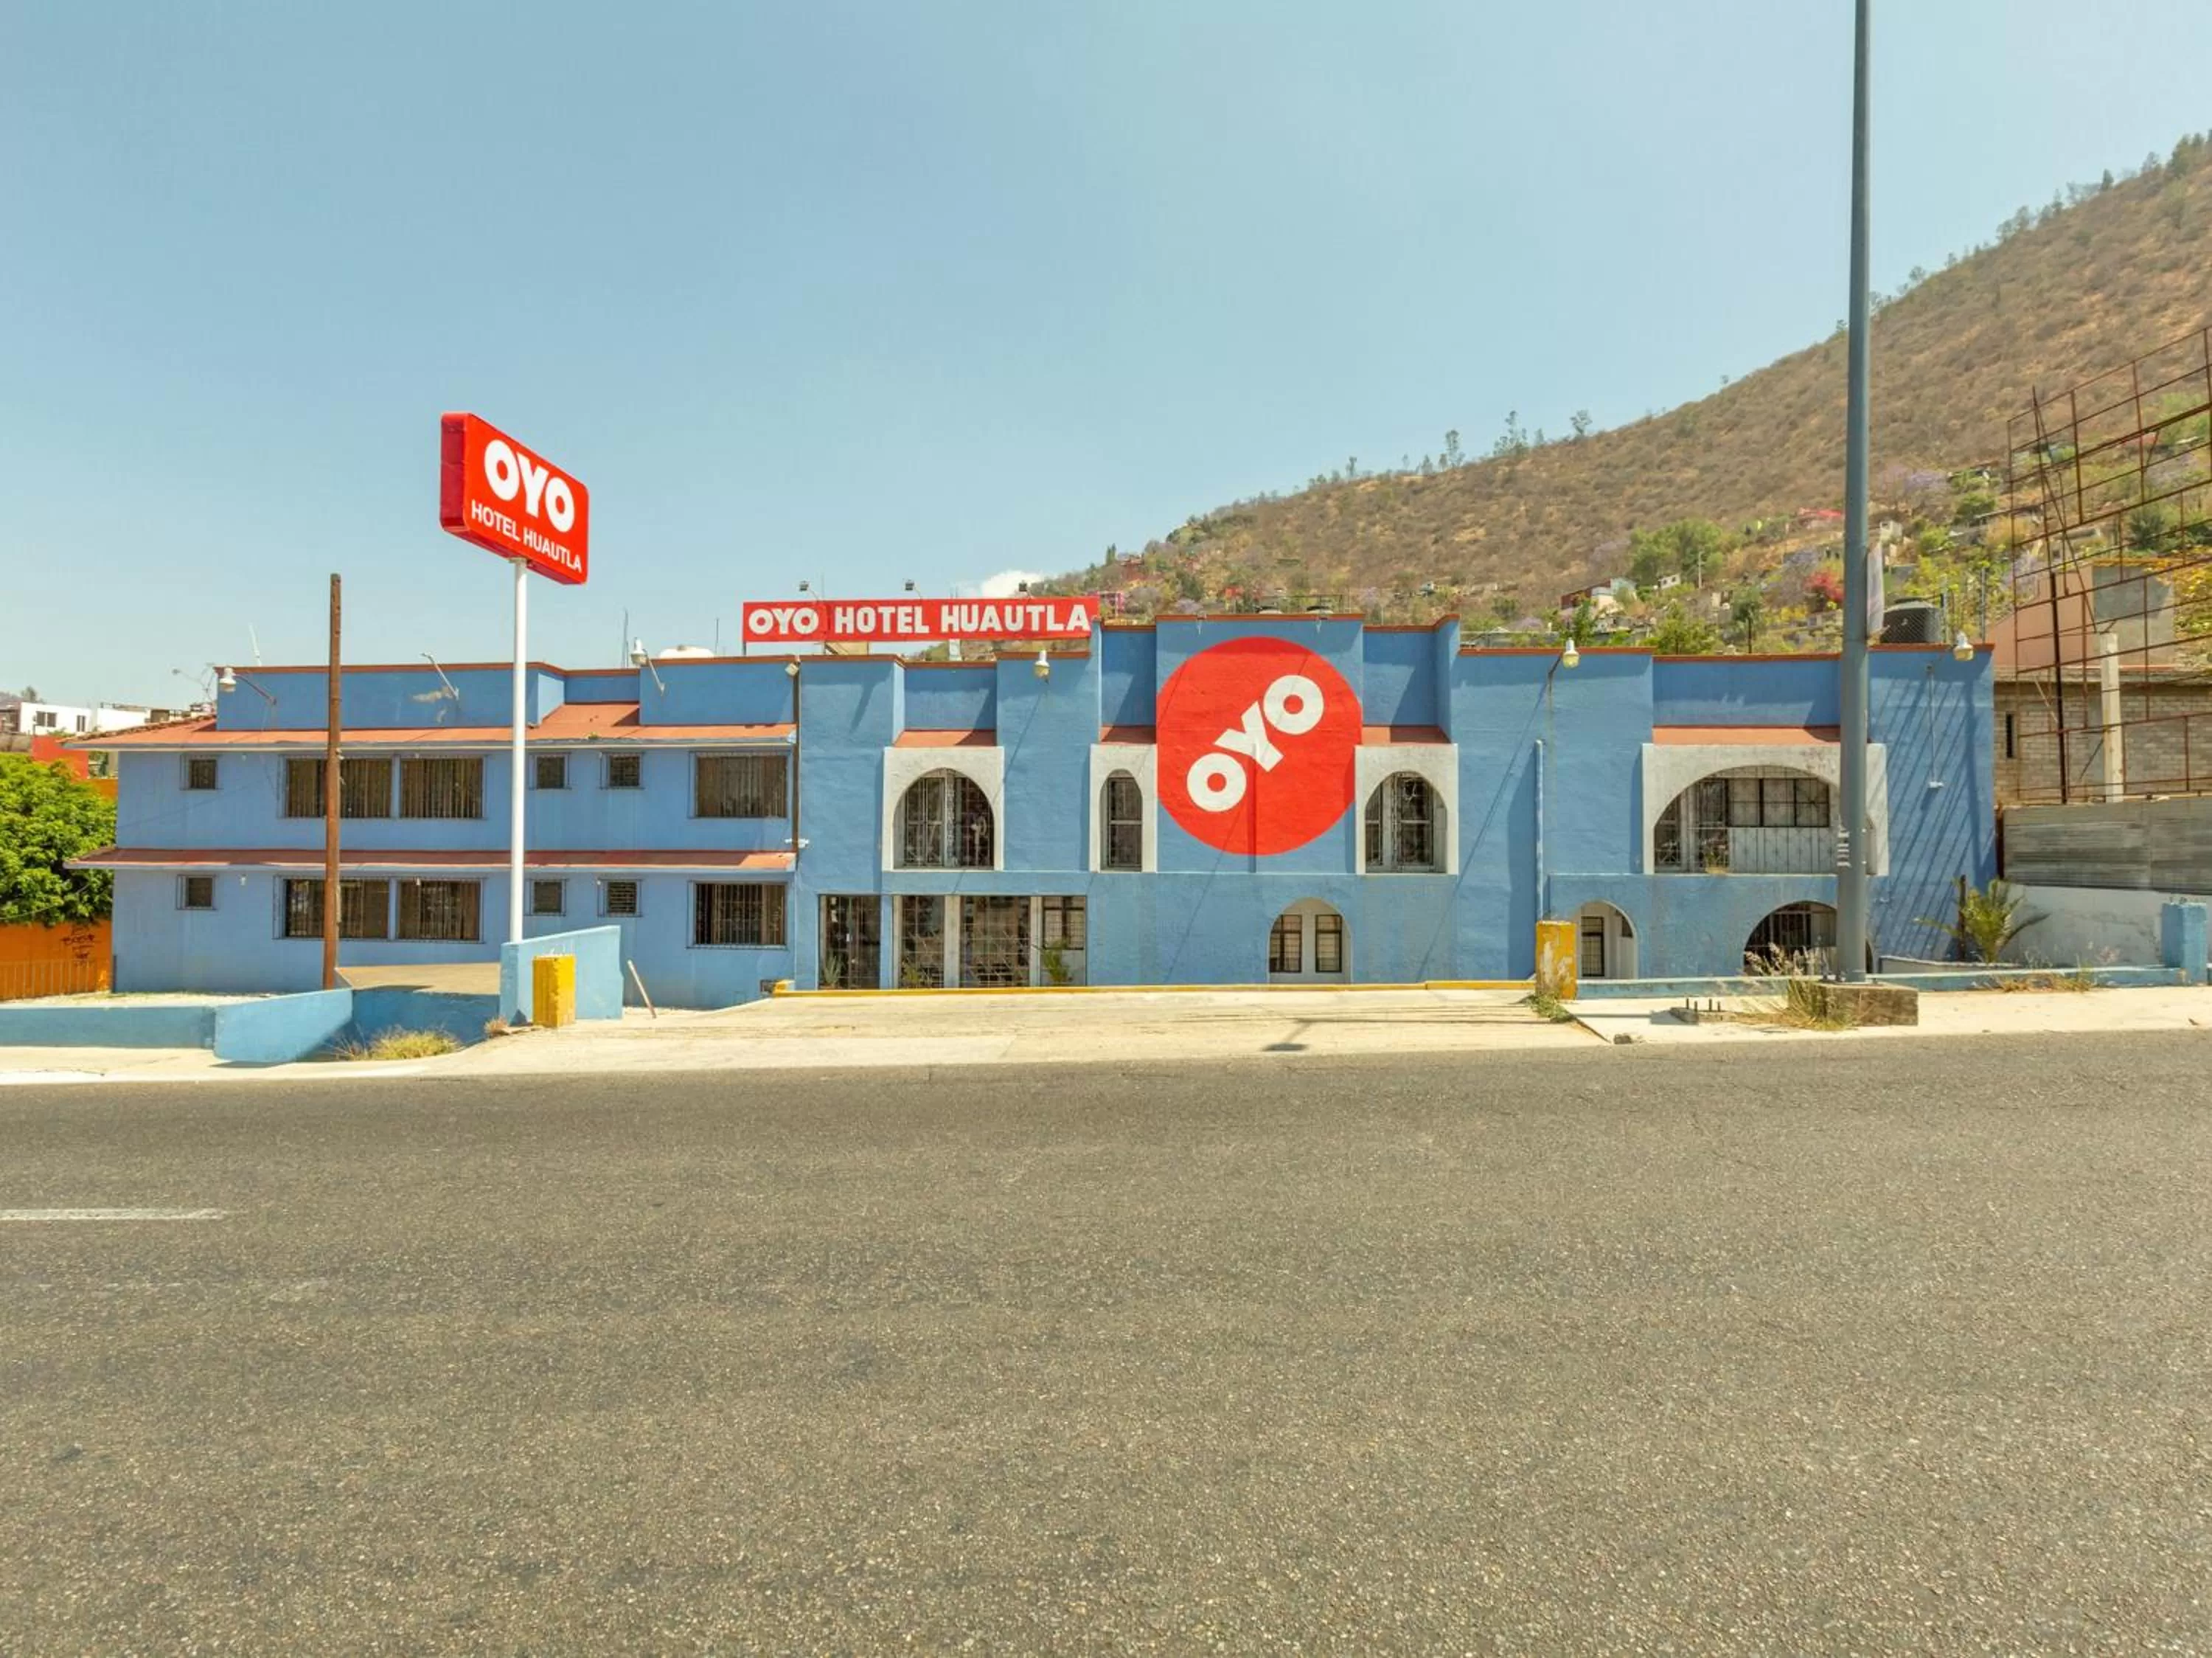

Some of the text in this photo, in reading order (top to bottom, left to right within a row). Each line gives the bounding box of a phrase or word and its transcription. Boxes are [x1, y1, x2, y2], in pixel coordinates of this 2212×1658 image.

[484, 439, 574, 533] OYO
[471, 499, 582, 572] HOTEL HUAUTLA
[748, 604, 1090, 634] OYO HOTEL HUAUTLA
[1186, 675, 1324, 812] OYO
